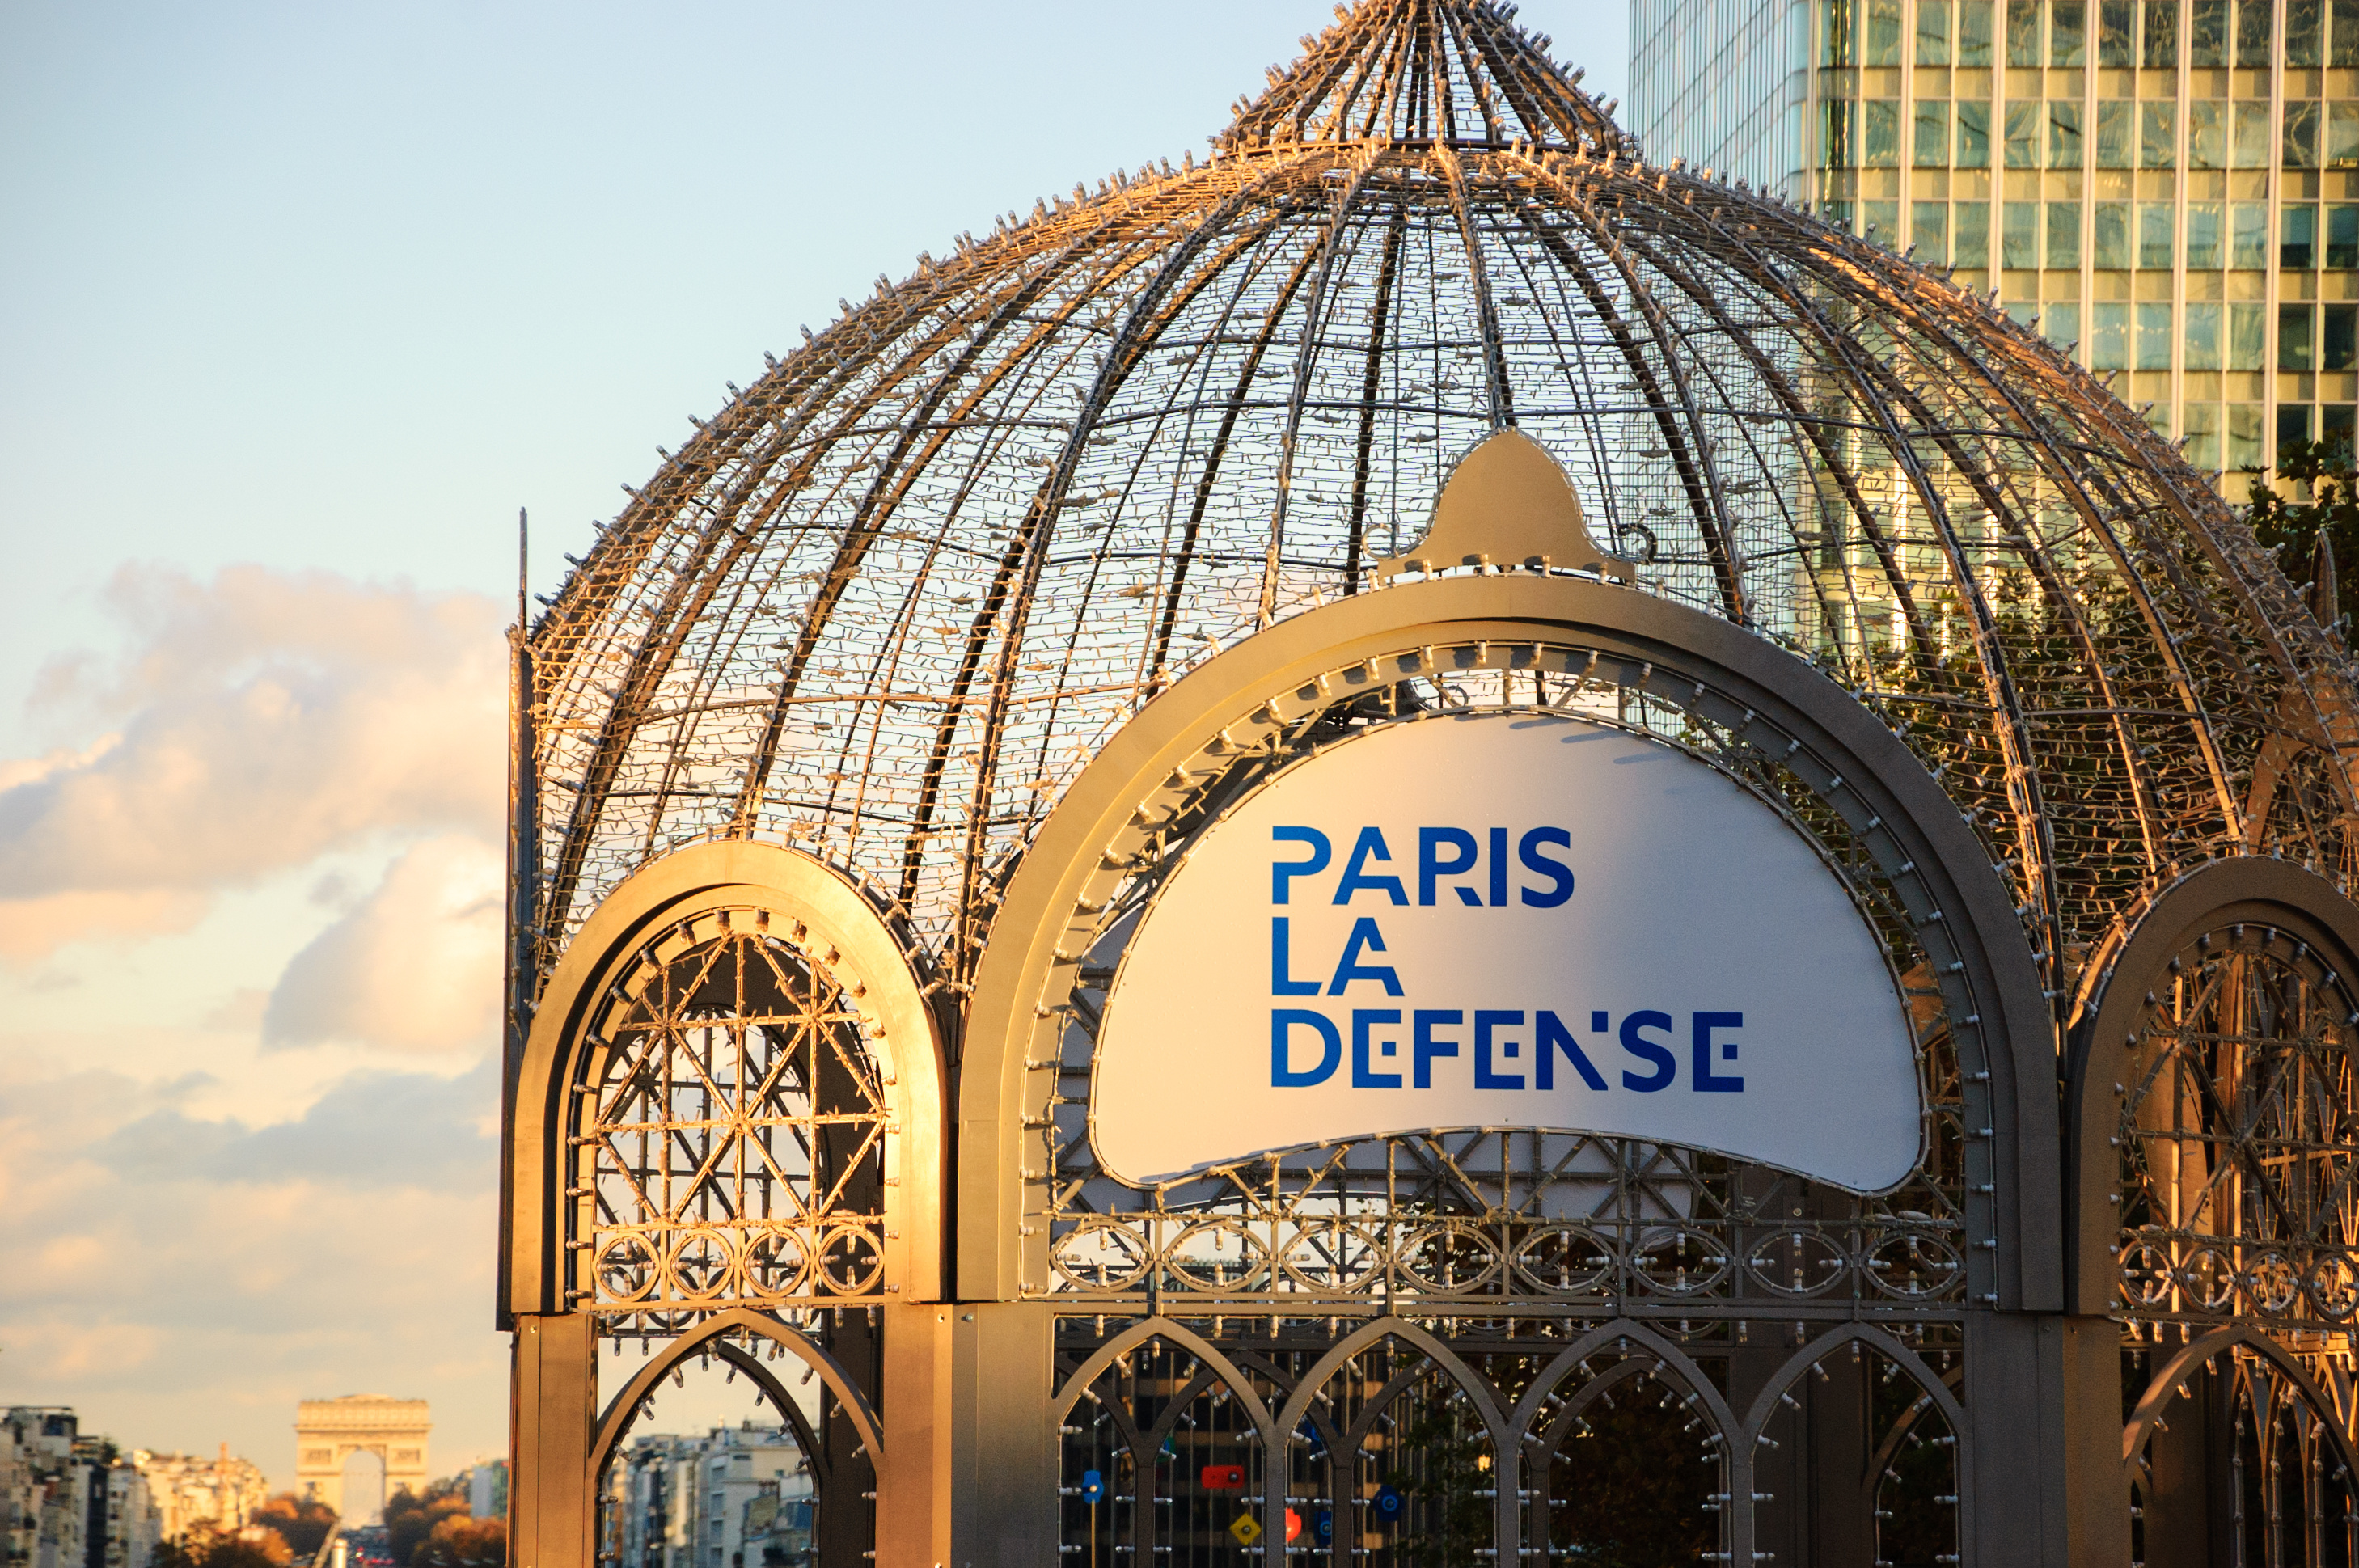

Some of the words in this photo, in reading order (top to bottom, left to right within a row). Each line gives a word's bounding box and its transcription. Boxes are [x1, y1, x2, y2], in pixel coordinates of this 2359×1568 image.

[1272, 826, 1575, 908] PARIS
[1271, 917, 1405, 996] LA
[1270, 1008, 1744, 1093] DEFENSE
